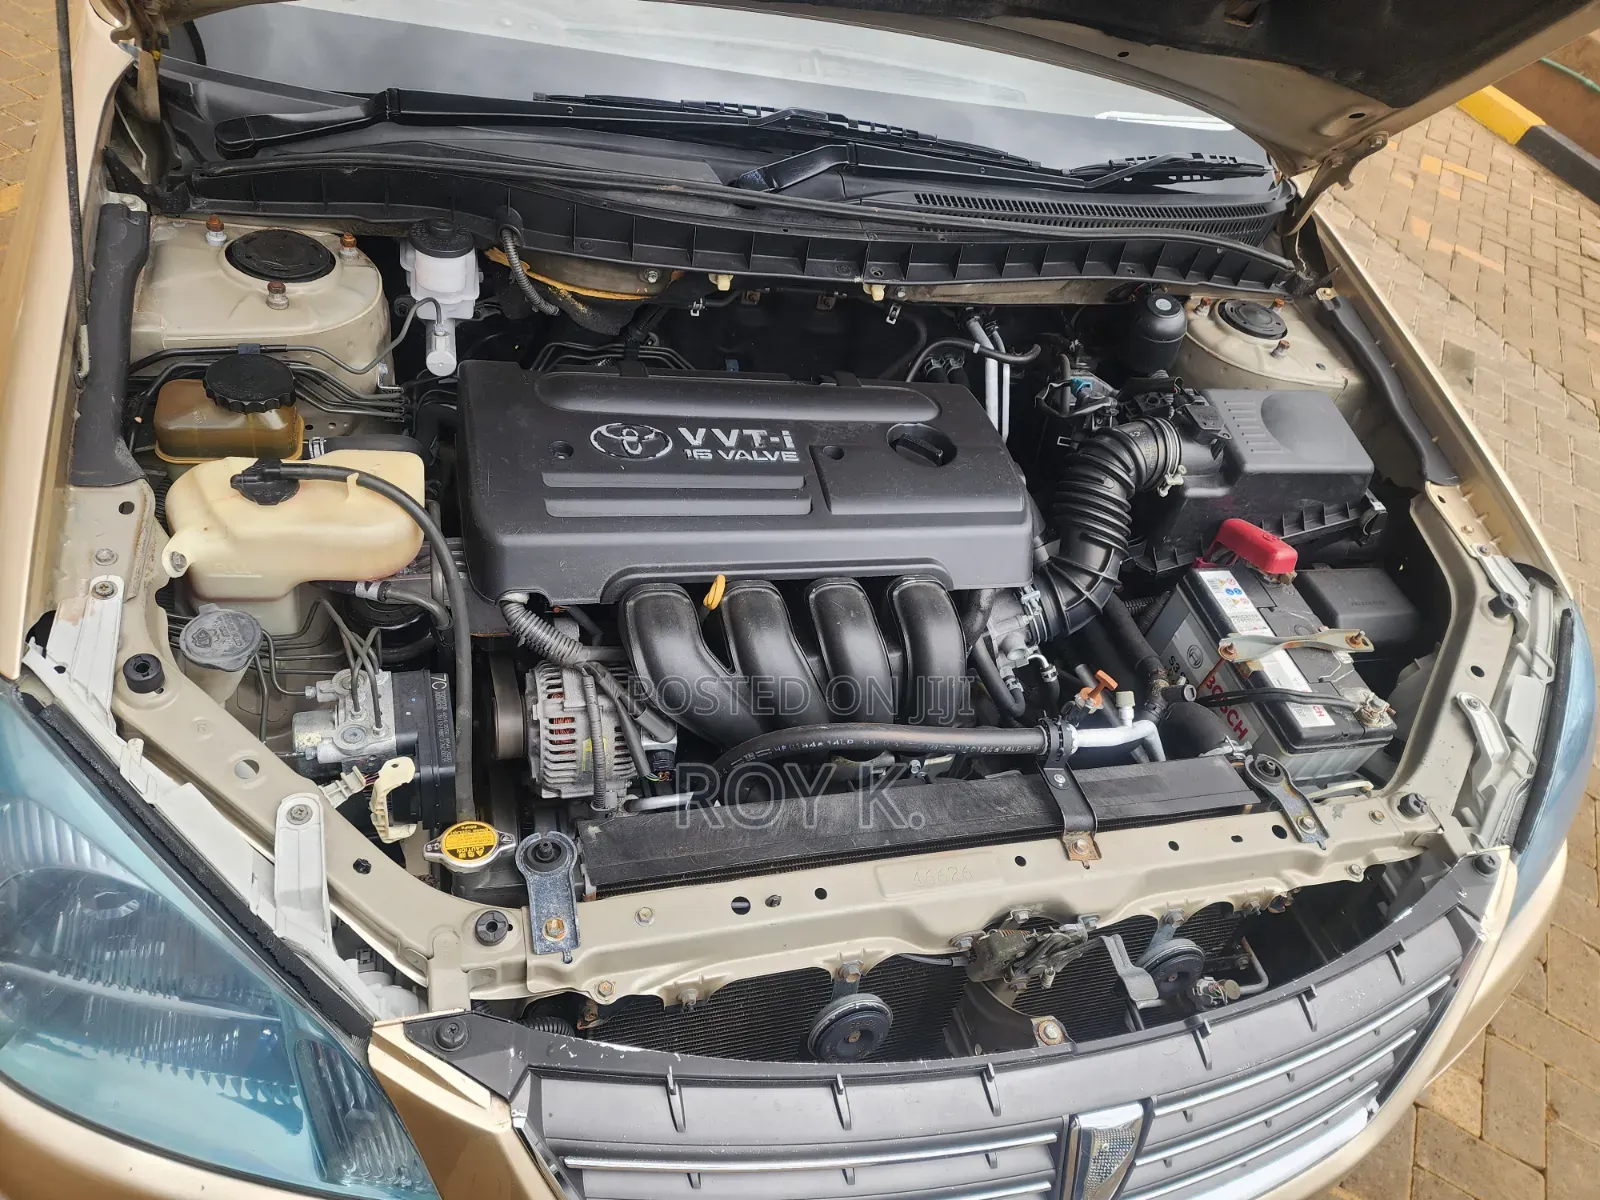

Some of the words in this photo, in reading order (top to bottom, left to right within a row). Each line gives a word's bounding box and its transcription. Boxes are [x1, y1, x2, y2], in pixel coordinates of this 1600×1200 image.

[678, 427, 795, 448] VVT-i
[683, 448, 713, 460] 16
[717, 449, 799, 462] VALVE
[431, 674, 447, 690] 7C
